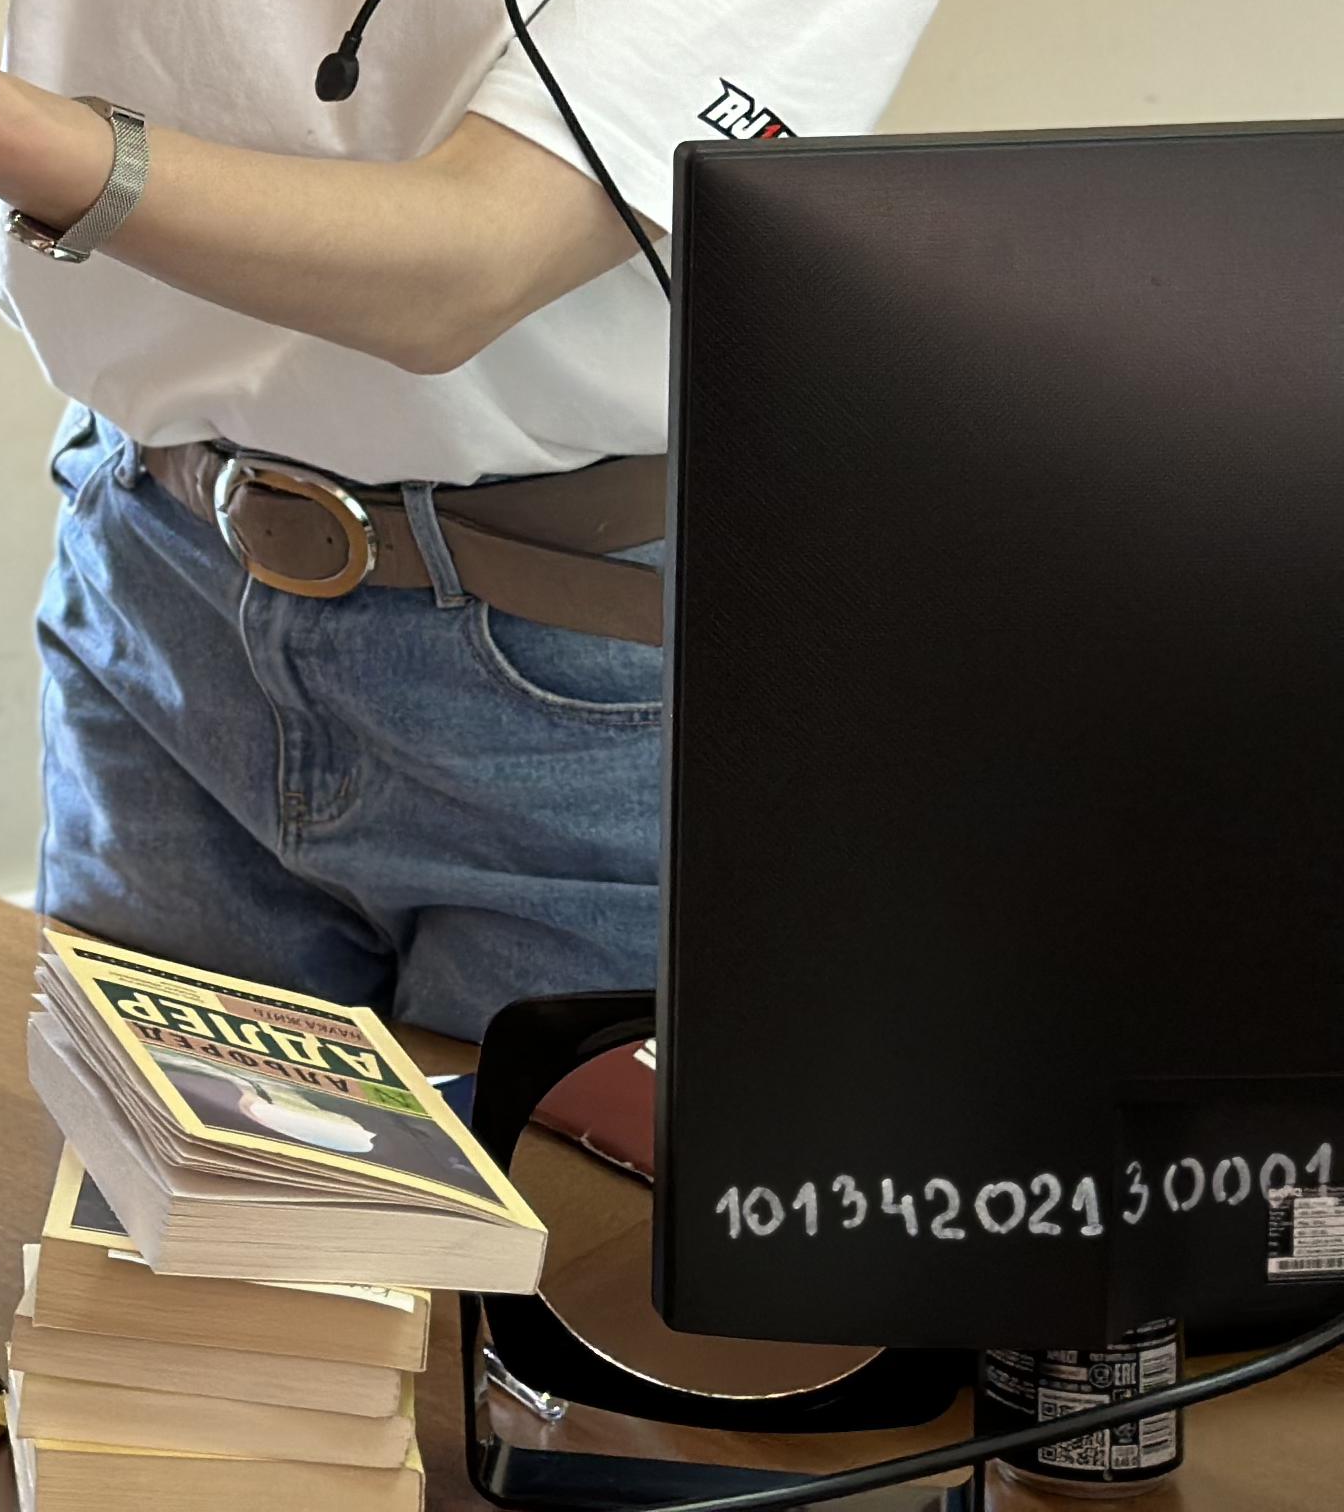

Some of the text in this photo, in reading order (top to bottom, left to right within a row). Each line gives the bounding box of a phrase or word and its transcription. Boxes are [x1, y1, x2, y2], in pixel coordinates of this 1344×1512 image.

[116, 991, 384, 1082] АДЛЕР
[132, 1020, 350, 1094] АЛЬФРЕД
[252, 1007, 364, 1041] НАУКА ЖИТЬ
